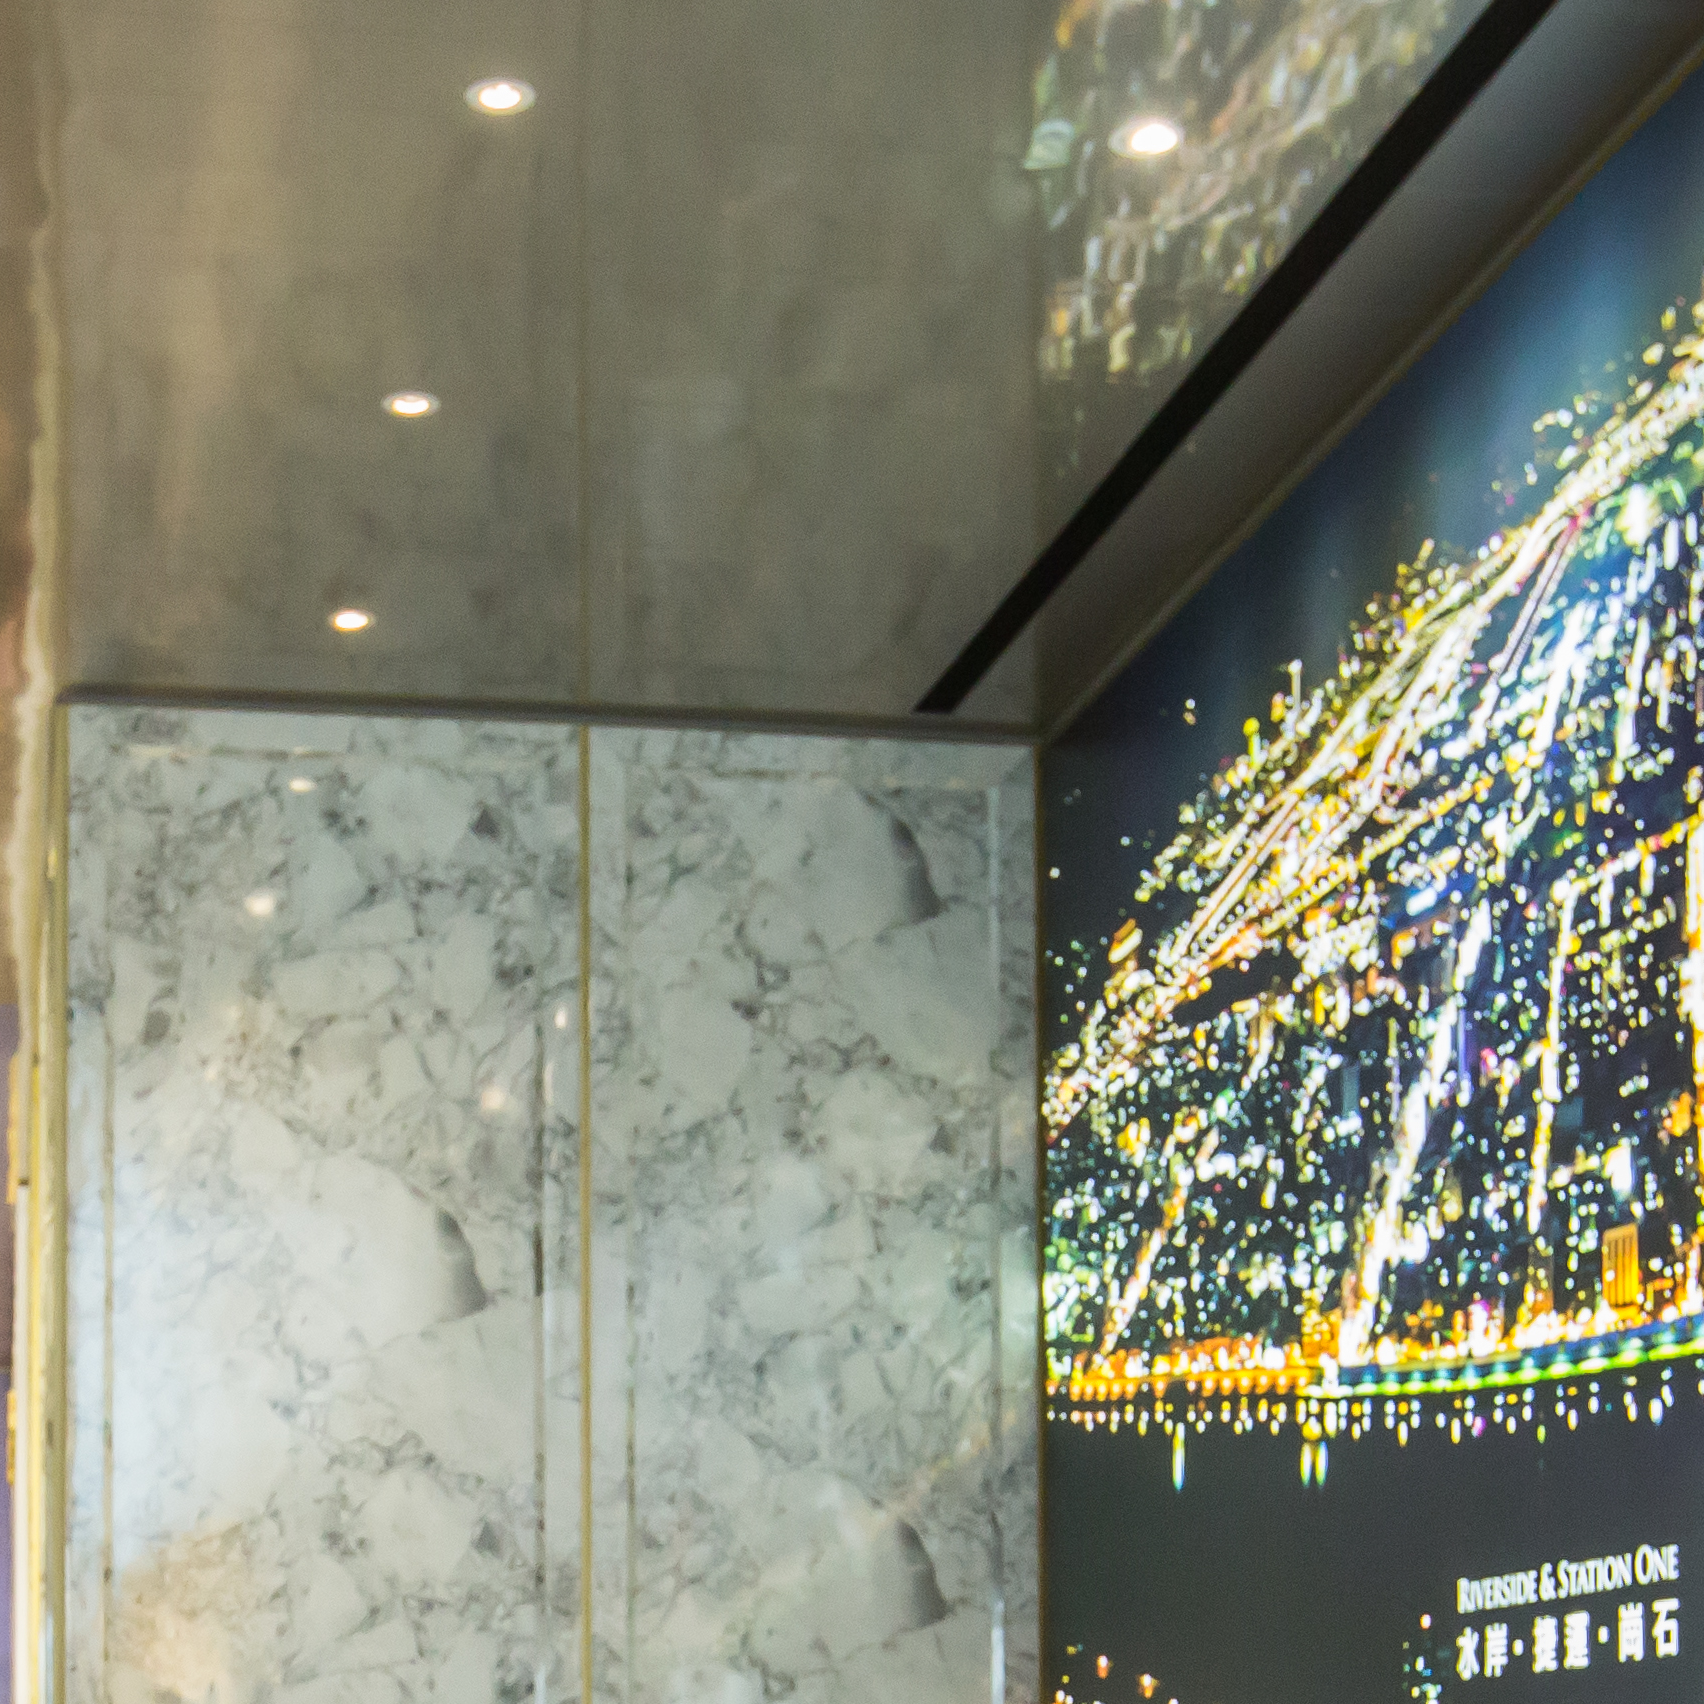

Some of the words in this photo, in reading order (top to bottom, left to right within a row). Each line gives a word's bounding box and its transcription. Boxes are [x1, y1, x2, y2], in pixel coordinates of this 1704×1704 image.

[1456, 1569, 1538, 1615] RIVERSIDE
[1538, 1562, 1557, 1602] &
[1557, 1552, 1633, 1599] STATION
[1634, 1543, 1681, 1586] ONE
